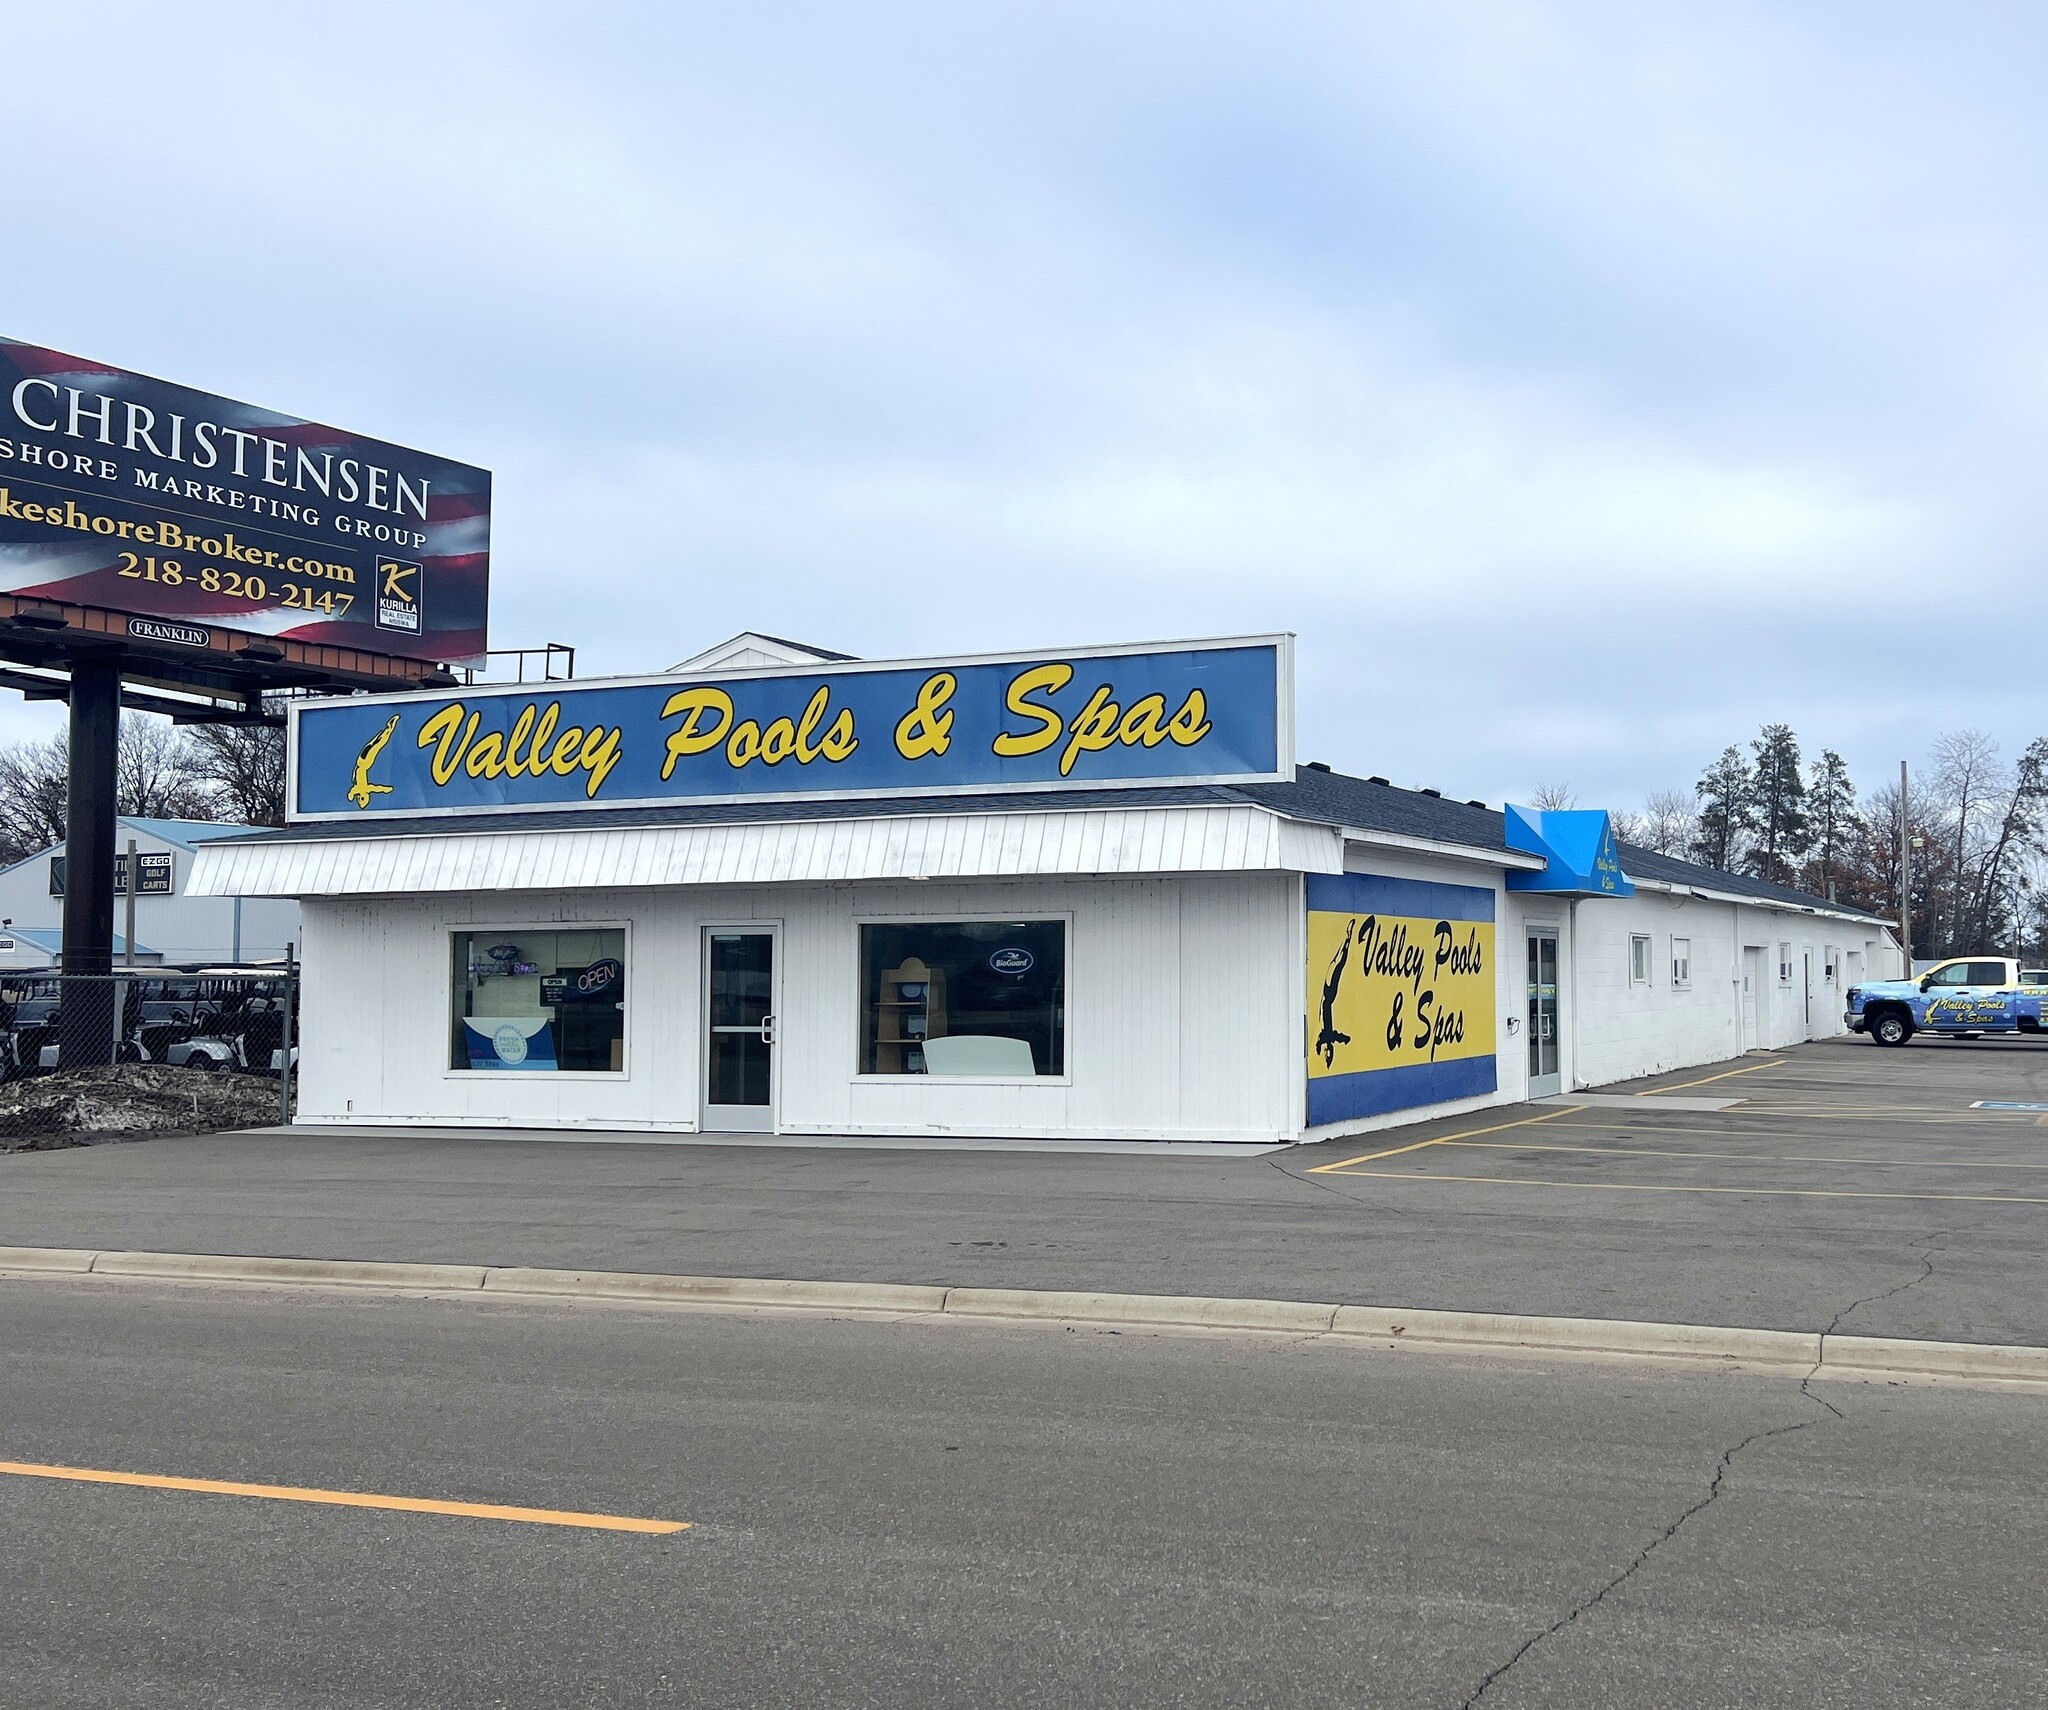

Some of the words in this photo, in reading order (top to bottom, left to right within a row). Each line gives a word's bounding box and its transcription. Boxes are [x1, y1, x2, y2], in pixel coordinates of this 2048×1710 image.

[12, 378, 431, 521] CHRISTENSEN
[0, 438, 118, 480] SHORE
[134, 468, 320, 526] MARKETING
[335, 515, 427, 549] GROUP
[0, 488, 356, 584] keshoreBroker.com
[118, 552, 355, 617] 218-820-2147
[380, 597, 417, 614] KURILLA
[382, 610, 396, 619] REAL
[396, 612, 416, 622] ESTATE
[135, 622, 203, 643] FRANKLIN
[417, 701, 623, 799] Valley
[660, 684, 859, 781] Pools
[895, 672, 957, 759] &
[992, 662, 1213, 777] Spas
[143, 880, 167, 889] CARTS
[146, 868, 165, 877] GOLF
[996, 958, 1028, 967] BioGuard
[1358, 915, 1424, 997] Valley
[1433, 920, 1482, 982] Pools
[578, 963, 615, 990] OPEN
[1940, 998, 1973, 1012] Valley
[1977, 999, 2006, 1011] Pools
[1386, 991, 1404, 1051] &
[1414, 989, 1465, 1062] Spas
[1955, 1012, 1964, 1022] &
[1966, 1012, 1994, 1024] Spas
